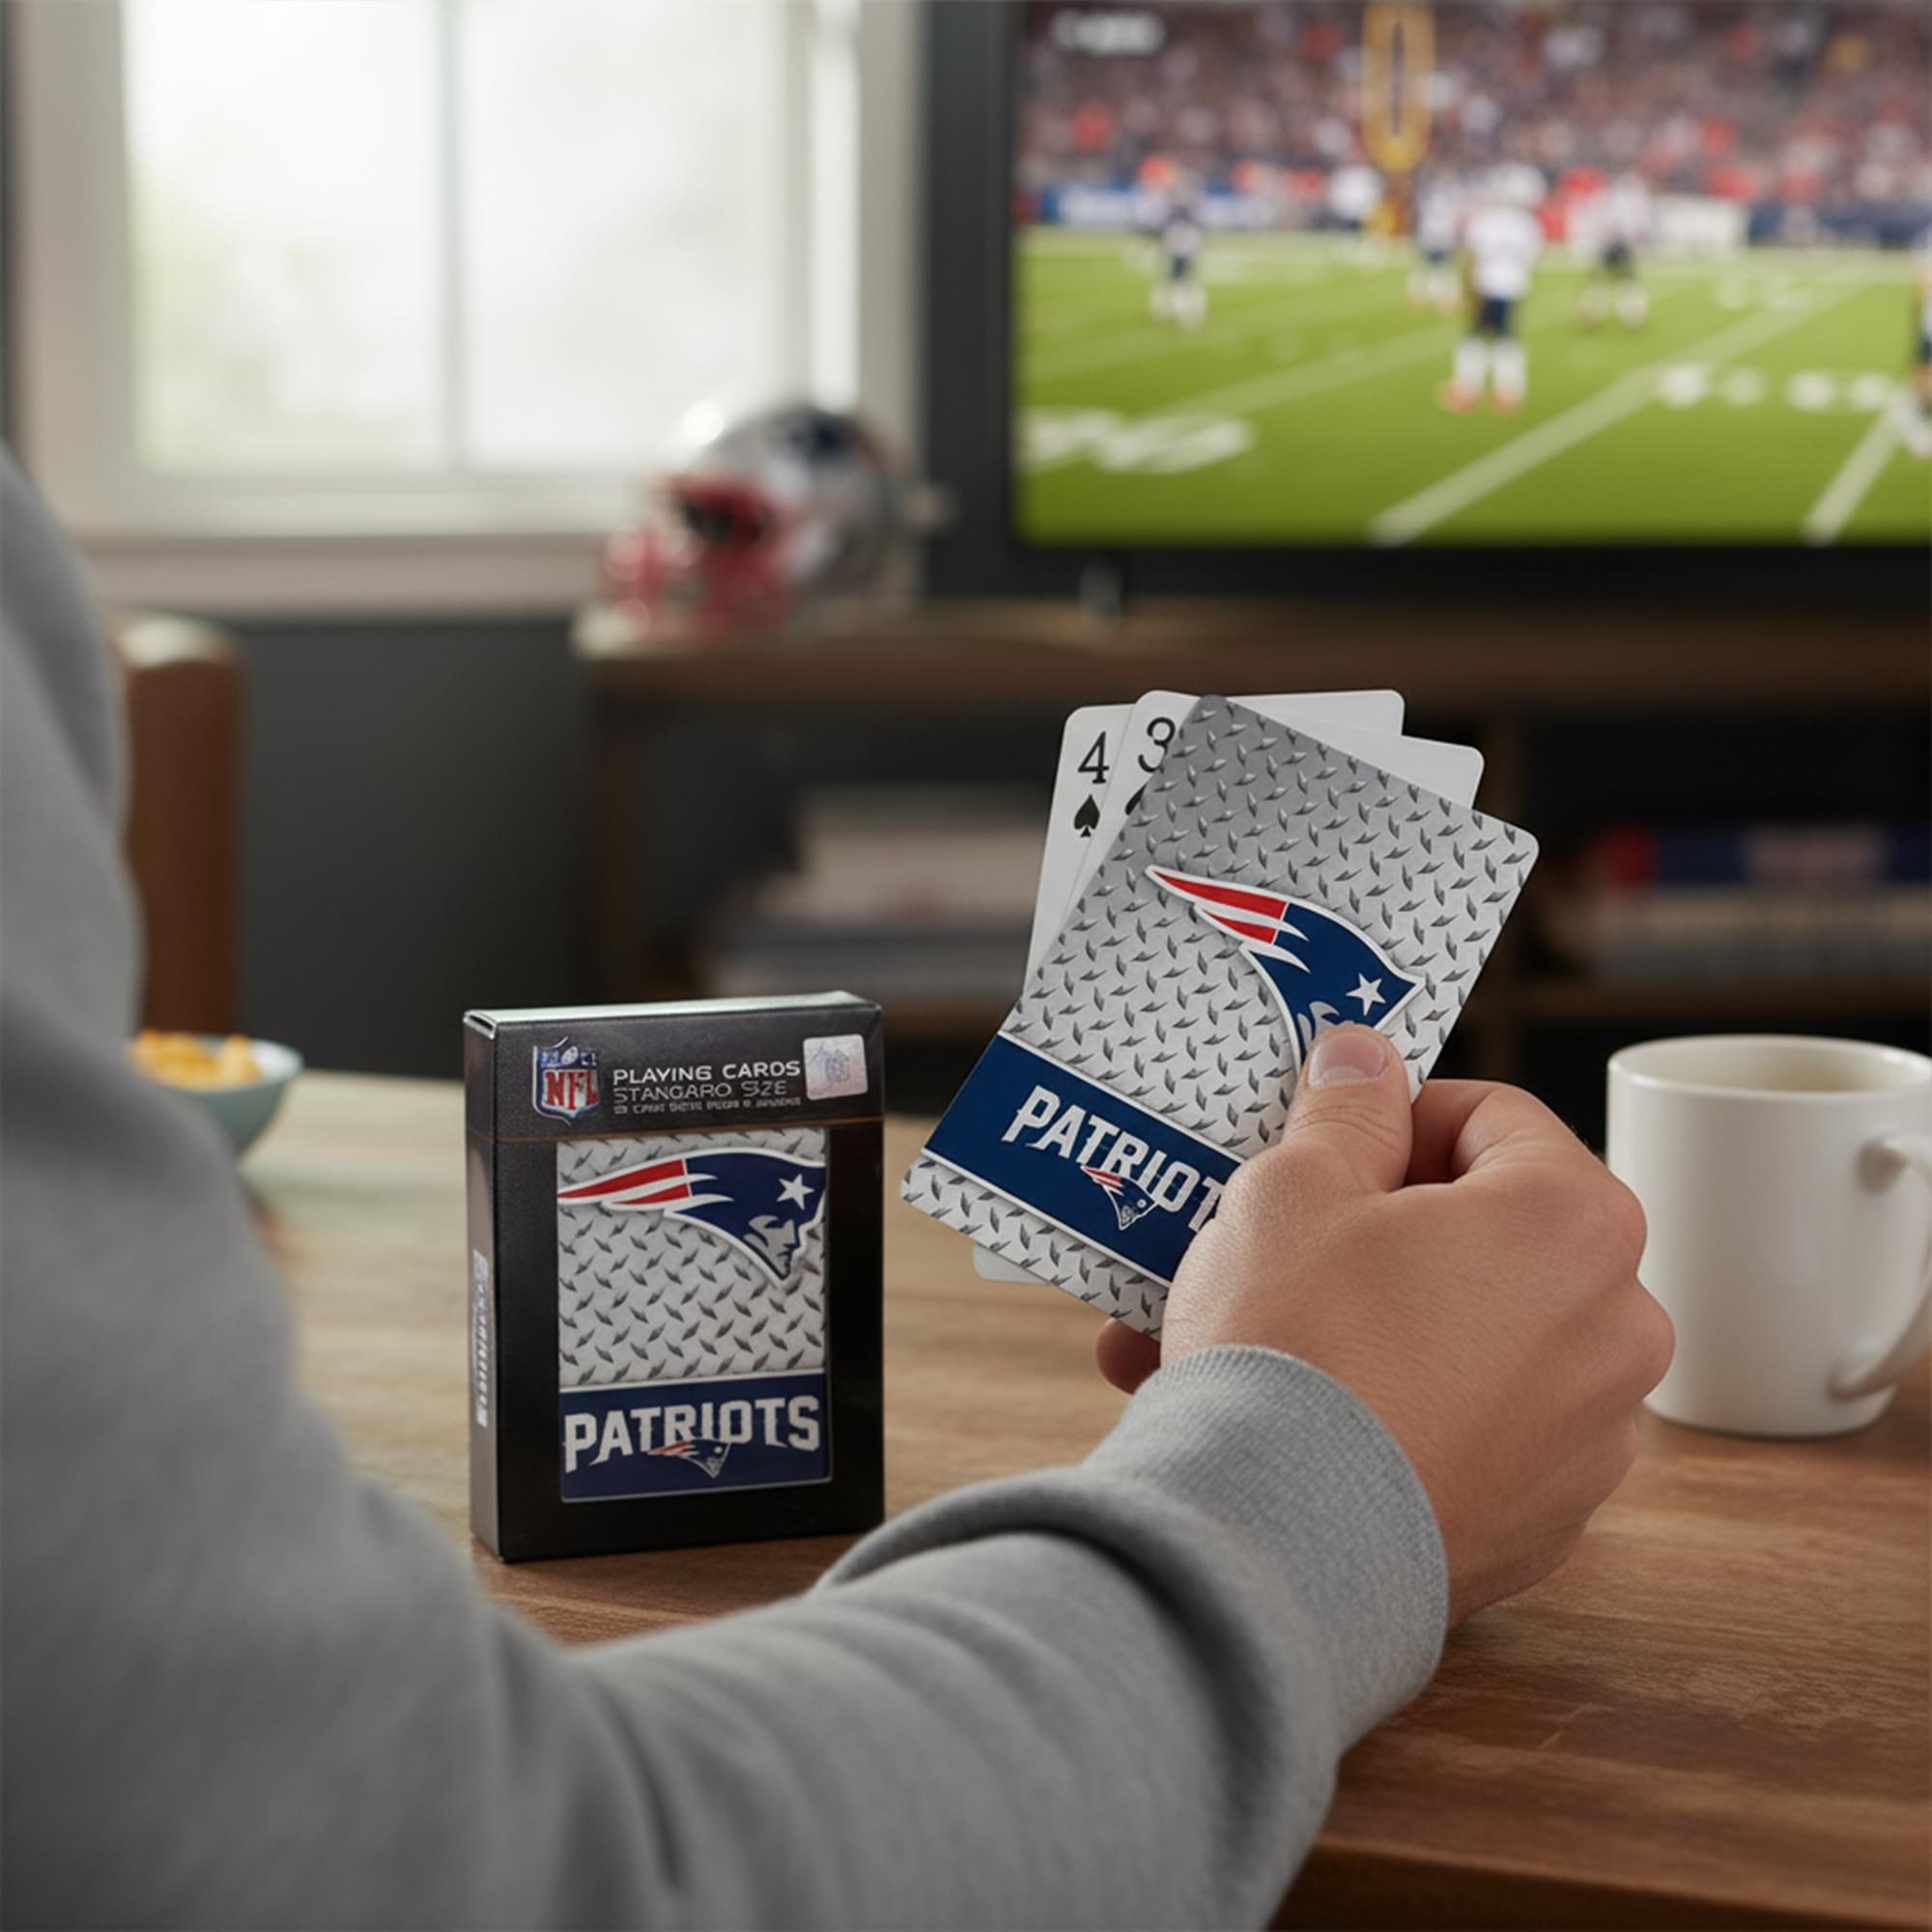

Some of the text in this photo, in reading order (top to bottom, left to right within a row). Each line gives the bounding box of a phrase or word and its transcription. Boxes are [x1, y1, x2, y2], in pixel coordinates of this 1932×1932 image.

[1077, 730, 1110, 784] 4
[1138, 716, 1176, 773] 3
[544, 1070, 600, 1111] NFL
[613, 1065, 712, 1086] PLAYING
[1001, 1084, 1225, 1234] PATRIOT
[562, 1395, 820, 1473] PATRIOTS
